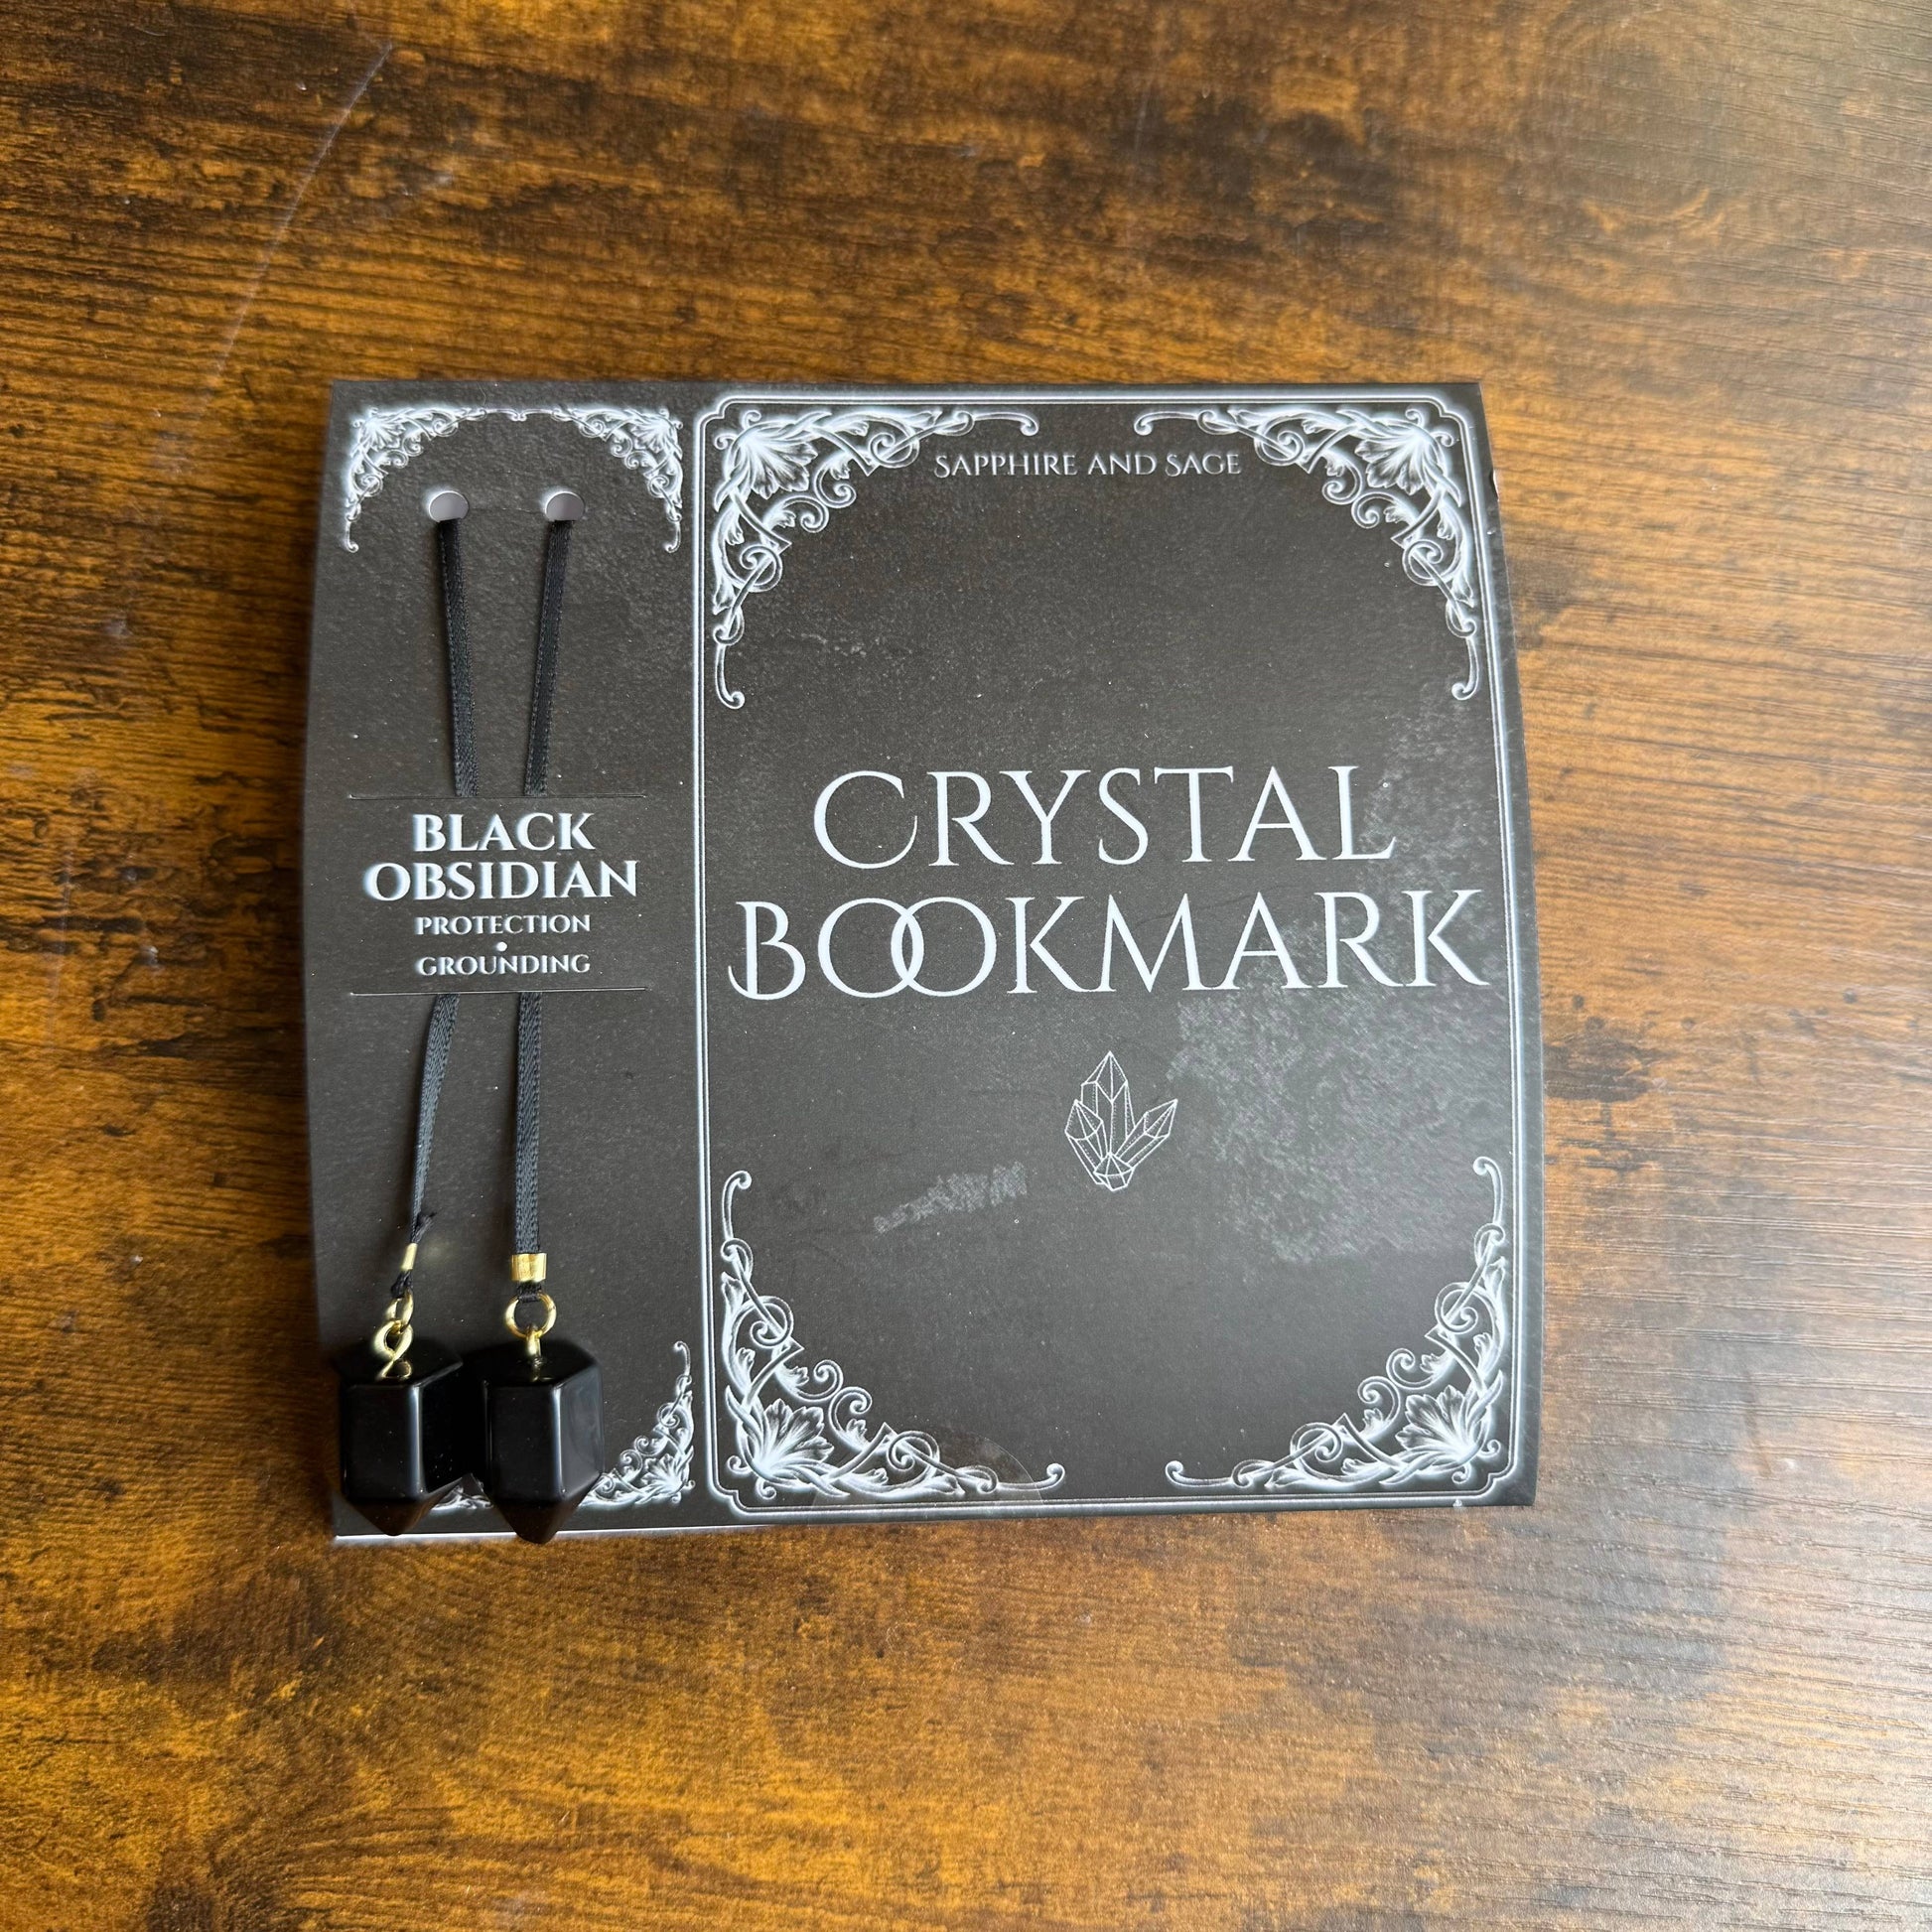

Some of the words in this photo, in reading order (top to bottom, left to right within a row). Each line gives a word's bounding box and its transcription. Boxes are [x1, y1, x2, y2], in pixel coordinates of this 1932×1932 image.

[933, 452, 1078, 479] SAPPHIRE
[1087, 452, 1158, 477] AND
[1165, 451, 1242, 478] SAGE
[411, 811, 597, 853] BLACK
[812, 764, 1396, 871] CRYSTAL
[362, 860, 641, 901] OBSIDIAN
[414, 913, 592, 935] PROTECTION
[414, 954, 592, 976] GROUNDING
[727, 888, 1492, 1002] BOOKMARK
